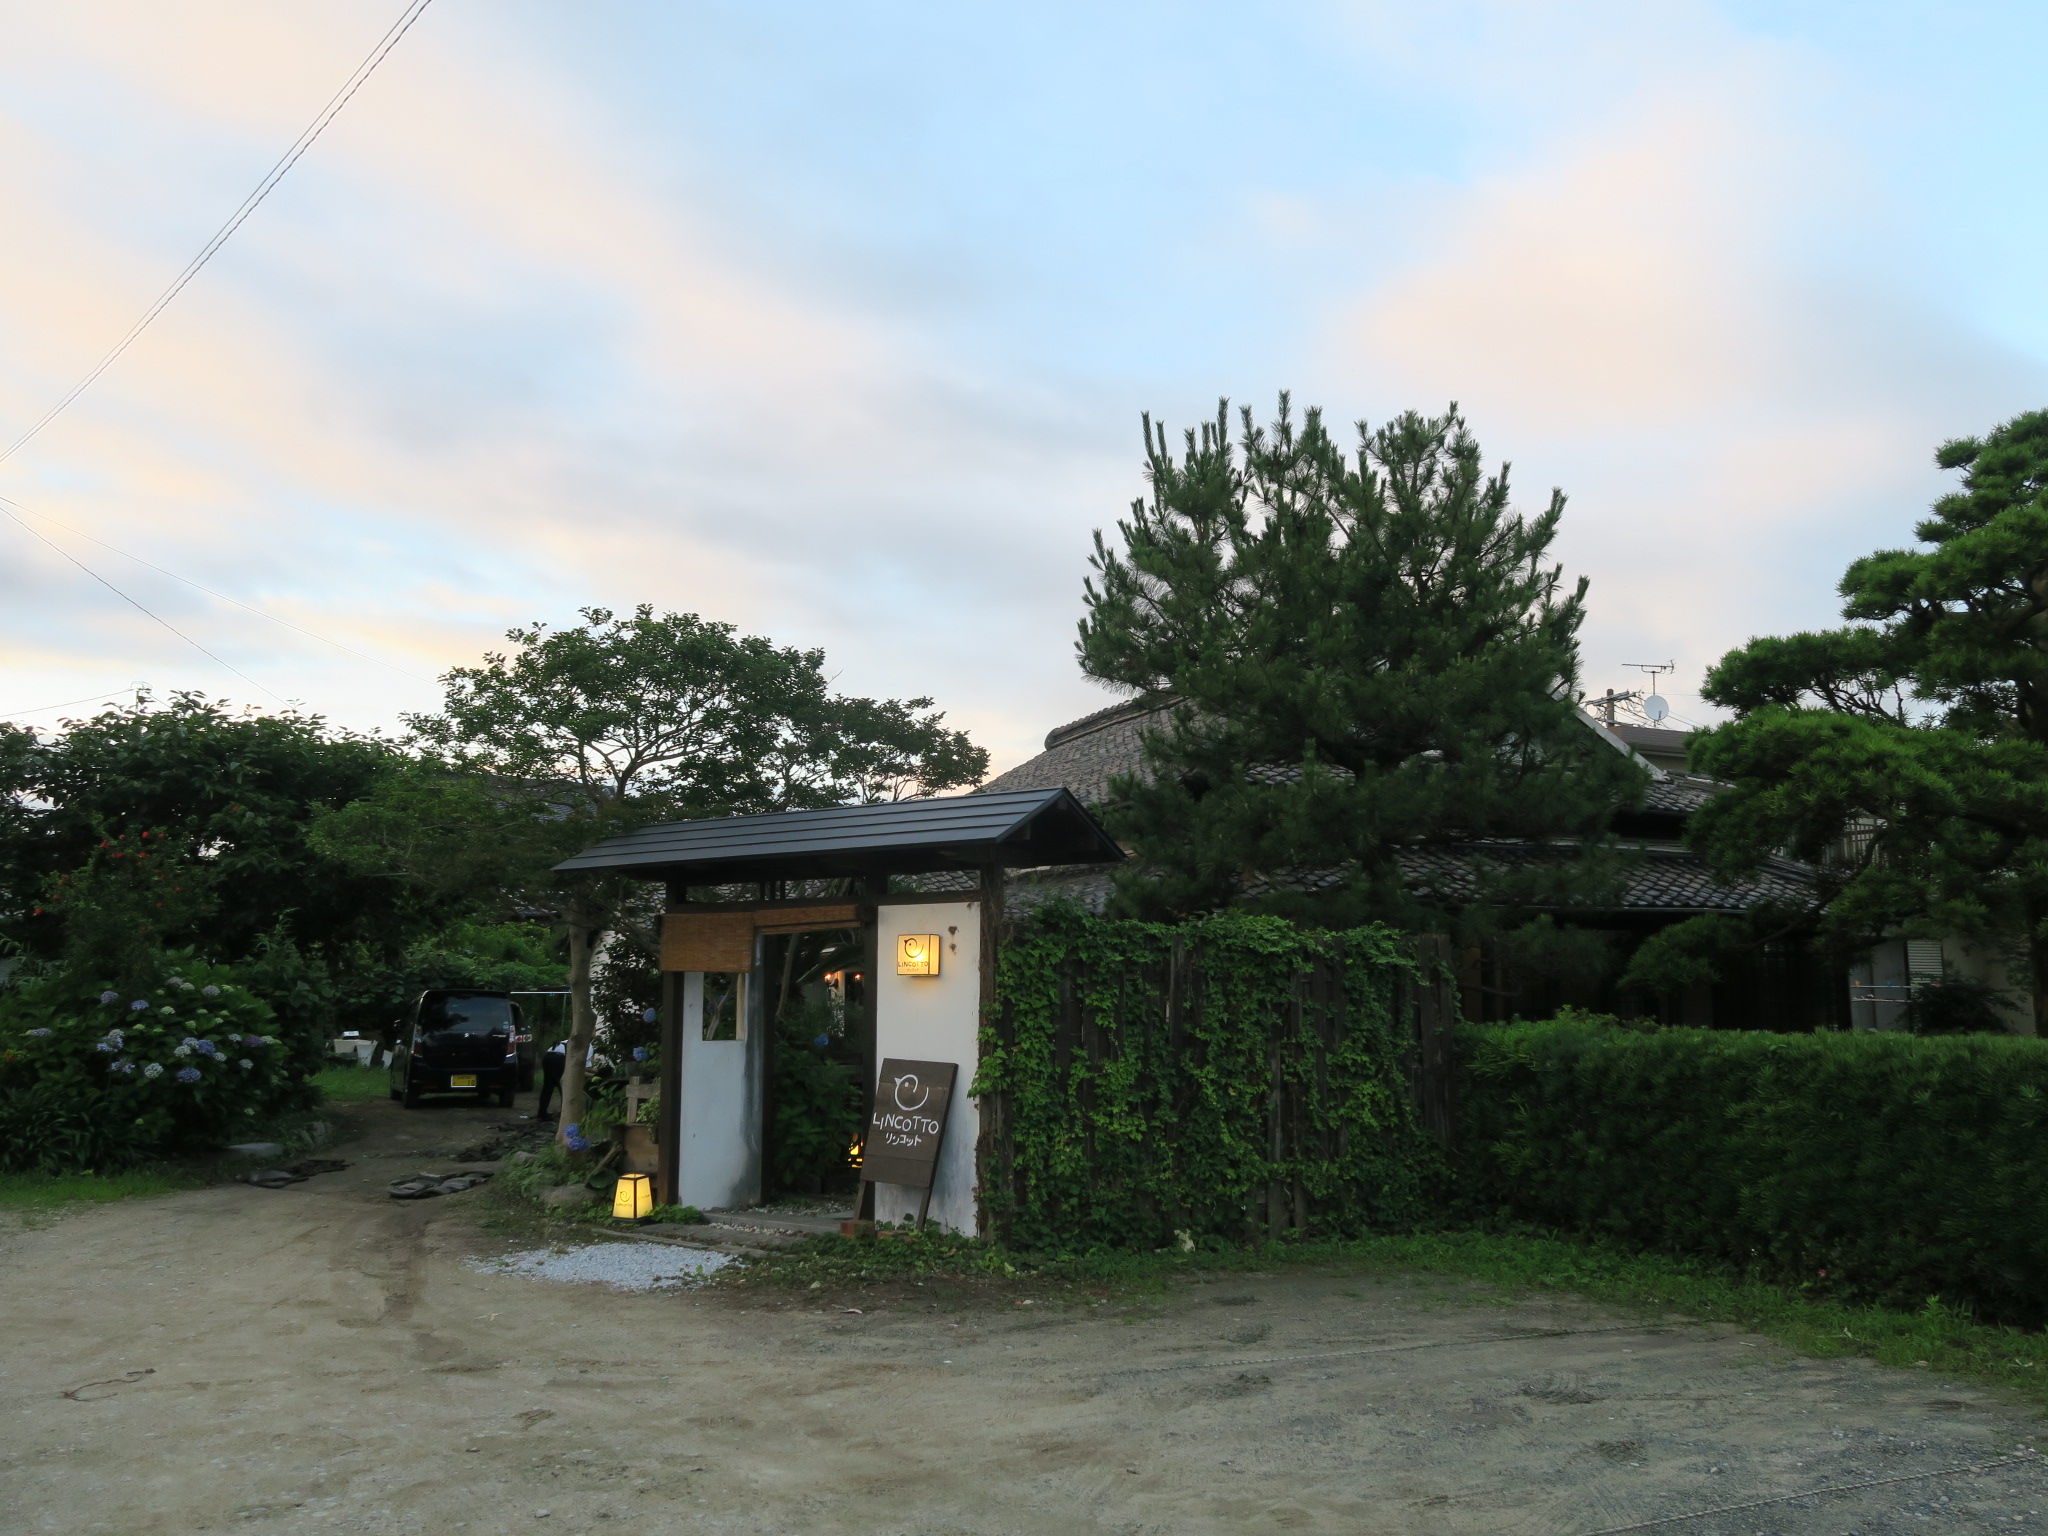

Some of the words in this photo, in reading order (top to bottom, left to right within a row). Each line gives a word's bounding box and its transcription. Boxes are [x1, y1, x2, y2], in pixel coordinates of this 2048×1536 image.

[872, 1112, 939, 1135] LINCOTTO
[885, 1133, 922, 1147] リンコット
